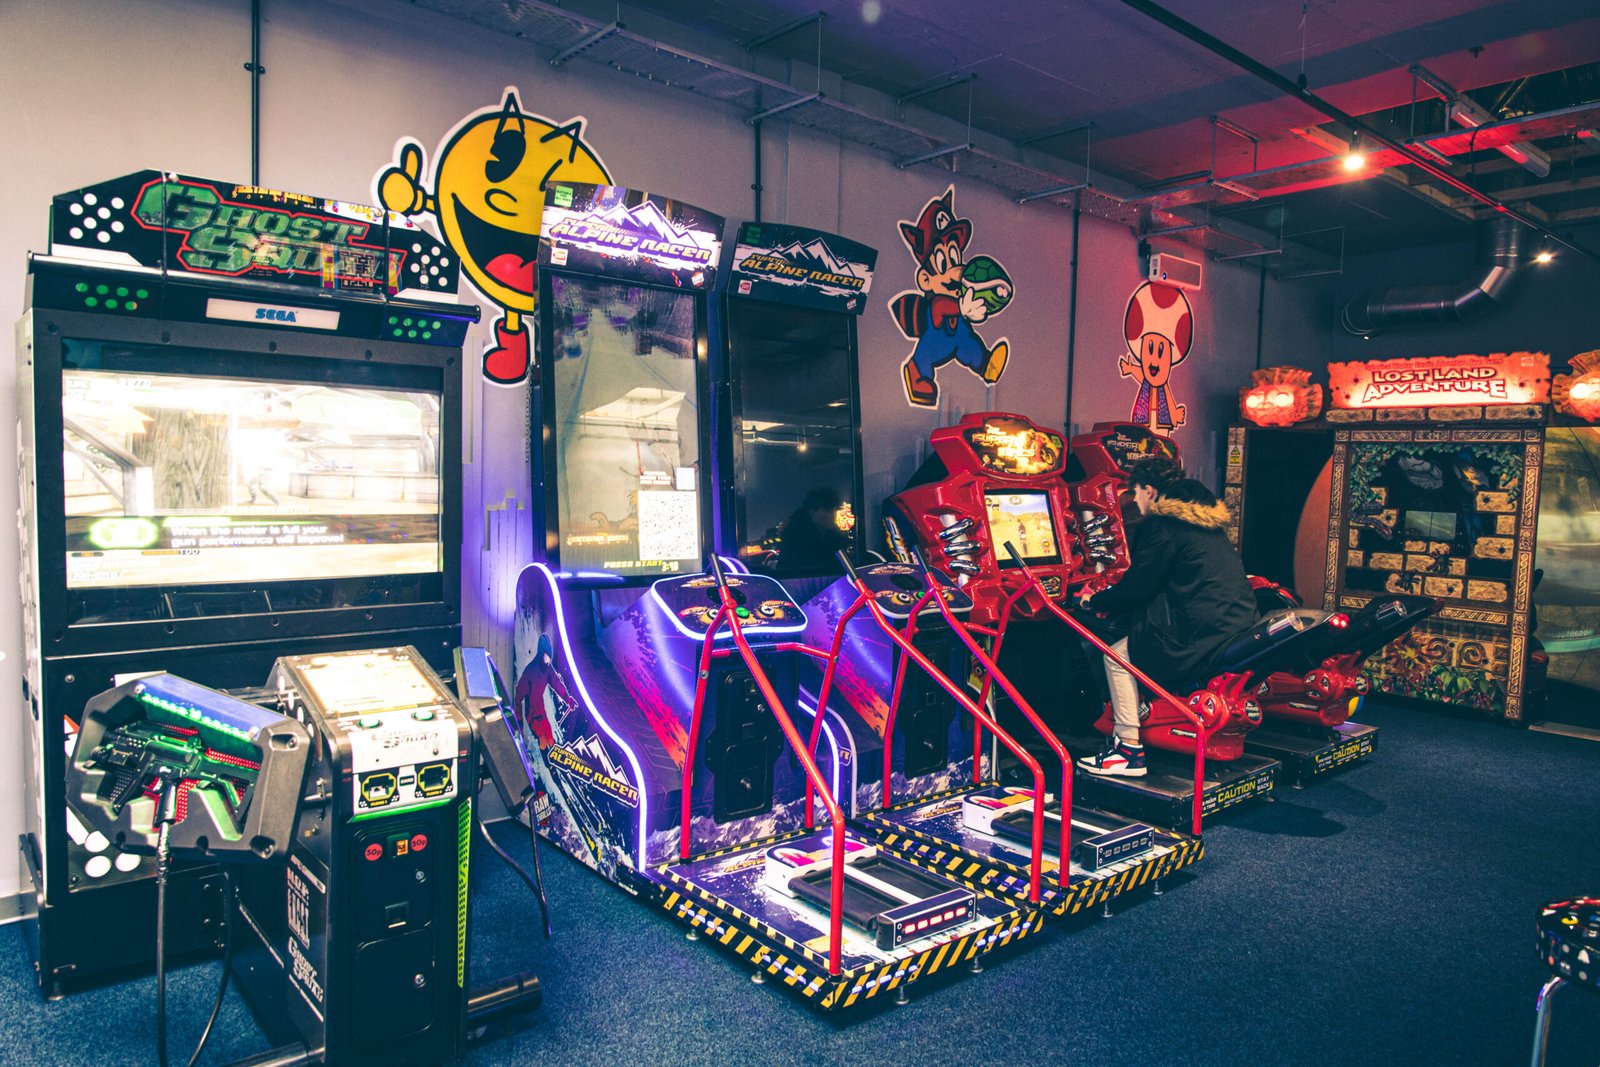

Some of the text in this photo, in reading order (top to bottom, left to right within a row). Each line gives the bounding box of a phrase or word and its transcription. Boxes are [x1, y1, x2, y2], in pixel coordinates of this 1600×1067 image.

[137, 183, 366, 243] GHOST
[550, 224, 712, 262] ALPINE RACER
[741, 259, 864, 288] ALPINE RACER
[255, 308, 296, 323] SEGA
[1373, 367, 1497, 383] LOST LAND
[1362, 379, 1508, 403] ADVENTURE
[171, 526, 207, 536] When
[210, 526, 230, 535] the
[233, 526, 267, 535] meter
[302, 526, 327, 535] your
[171, 539, 196, 548] gun
[199, 536, 274, 547] performance
[604, 561, 634, 569] PRESS
[1333, 744, 1360, 760] CAUTION
[549, 751, 638, 801] ALPINE RACER
[1257, 776, 1269, 784] STAY
[1218, 780, 1256, 803] CAUTION
[1257, 782, 1270, 791] BACK
[534, 793, 549, 812] RAW
[411, 839, 427, 848] 50p
[366, 848, 382, 857] 50p
